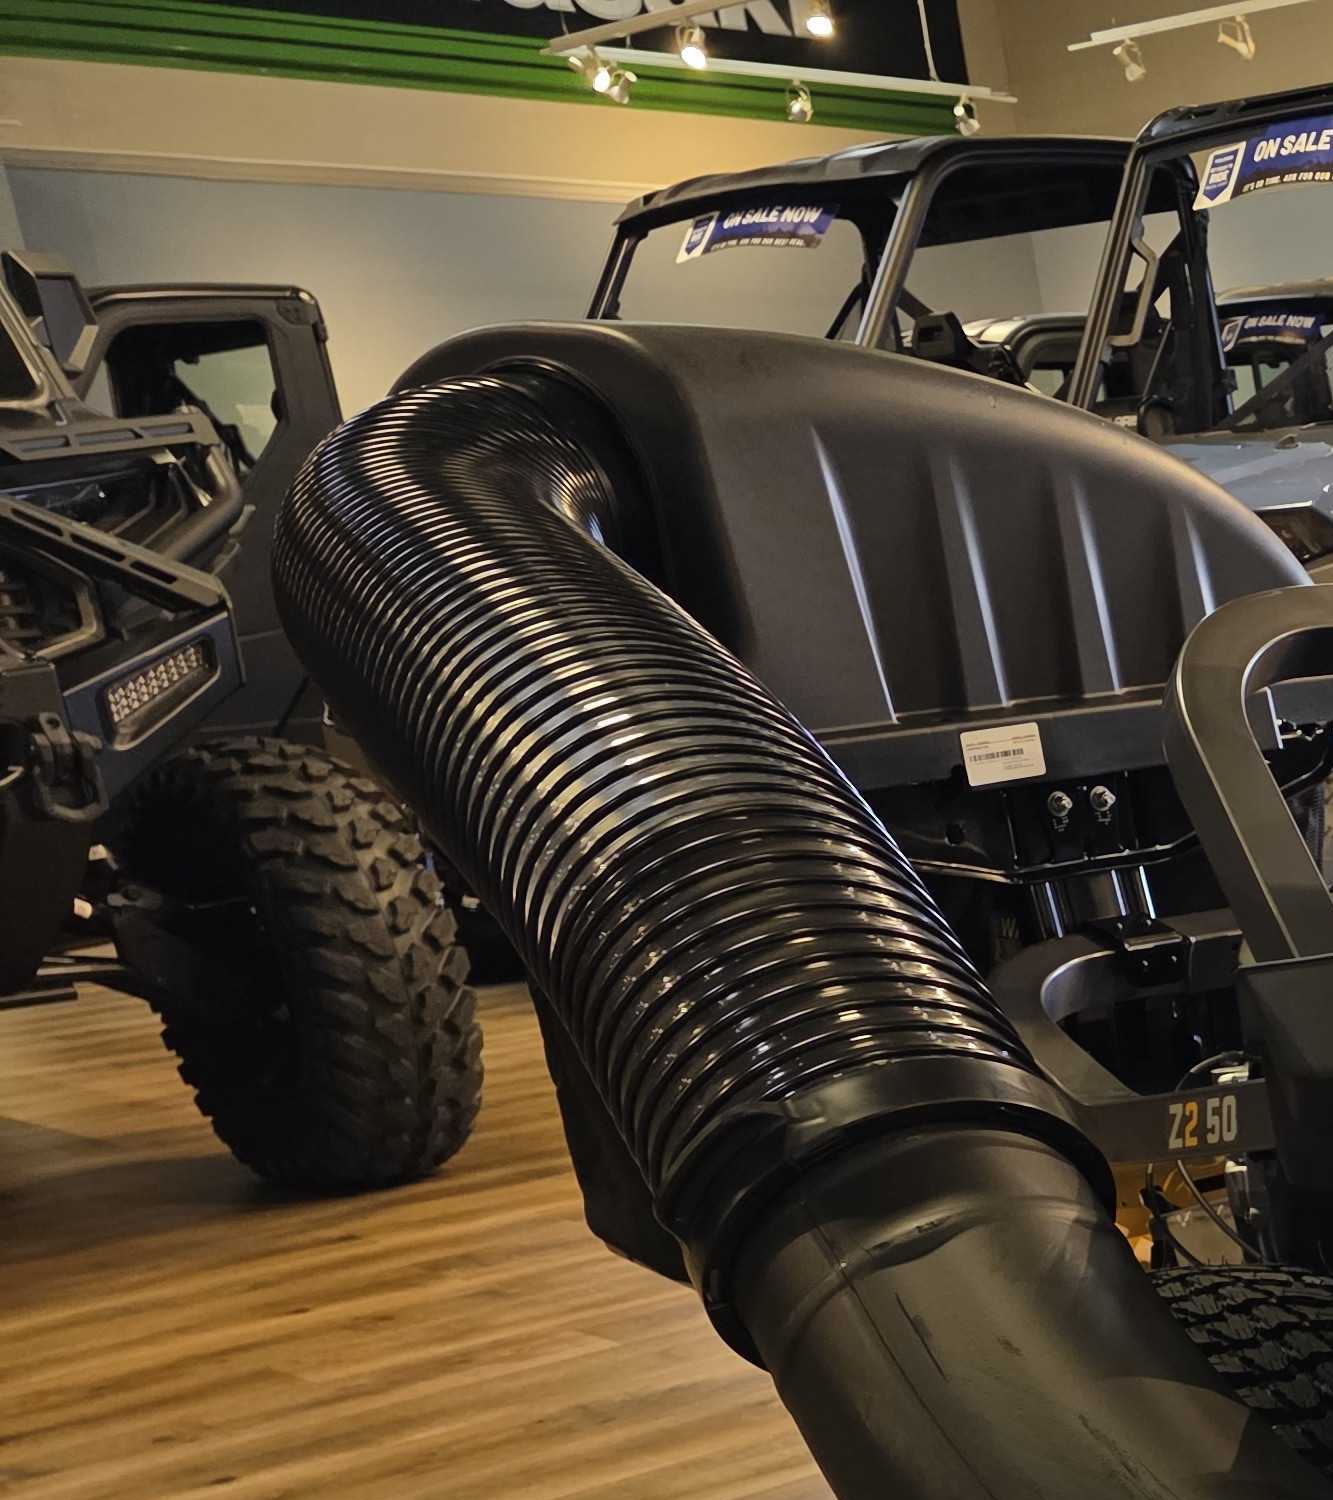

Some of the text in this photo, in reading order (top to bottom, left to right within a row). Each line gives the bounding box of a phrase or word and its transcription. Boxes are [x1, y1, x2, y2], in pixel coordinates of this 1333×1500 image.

[1253, 140, 1281, 162] ON
[741, 206, 782, 225] SALE
[780, 206, 823, 223] NOW
[1168, 1095, 1237, 1150] Z2 50
